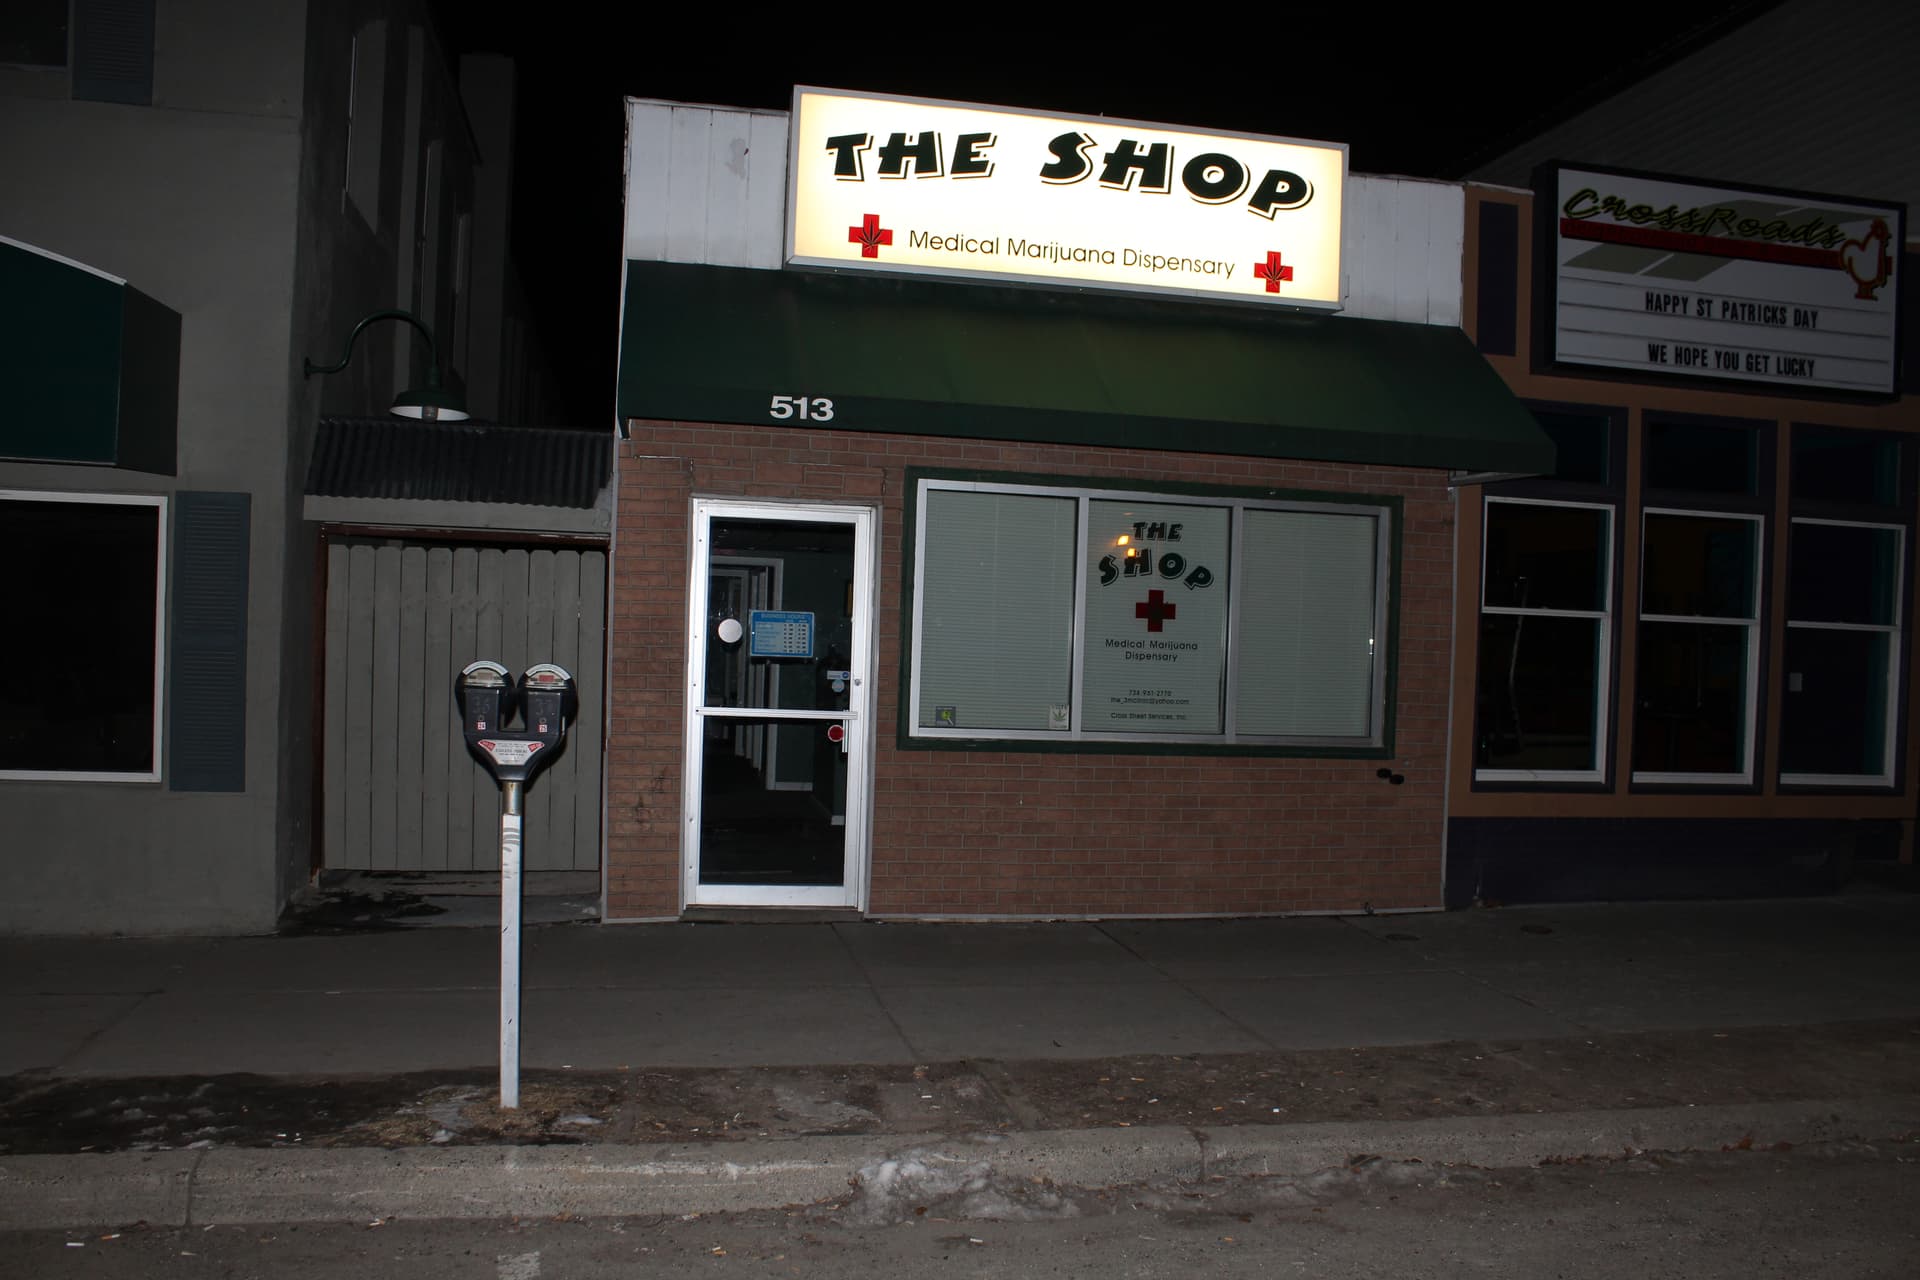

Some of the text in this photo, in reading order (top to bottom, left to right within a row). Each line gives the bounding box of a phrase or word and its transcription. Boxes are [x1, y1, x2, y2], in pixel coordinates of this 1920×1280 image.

[826, 131, 1314, 220] THE SHOP
[1563, 188, 1846, 248] CrossRoads
[909, 230, 1235, 279] Medical Marijuana Dispensary
[1646, 291, 1818, 328] HAPPY ST PATRICKS DAY
[1648, 343, 1815, 377] WE HOPE YOU GET LUCKY
[769, 395, 834, 421] 513
[1133, 521, 1184, 542] THE
[1099, 548, 1214, 590] SHOP
[1105, 638, 1198, 651] Medical Marijuana
[1125, 651, 1178, 662] Dispensary
